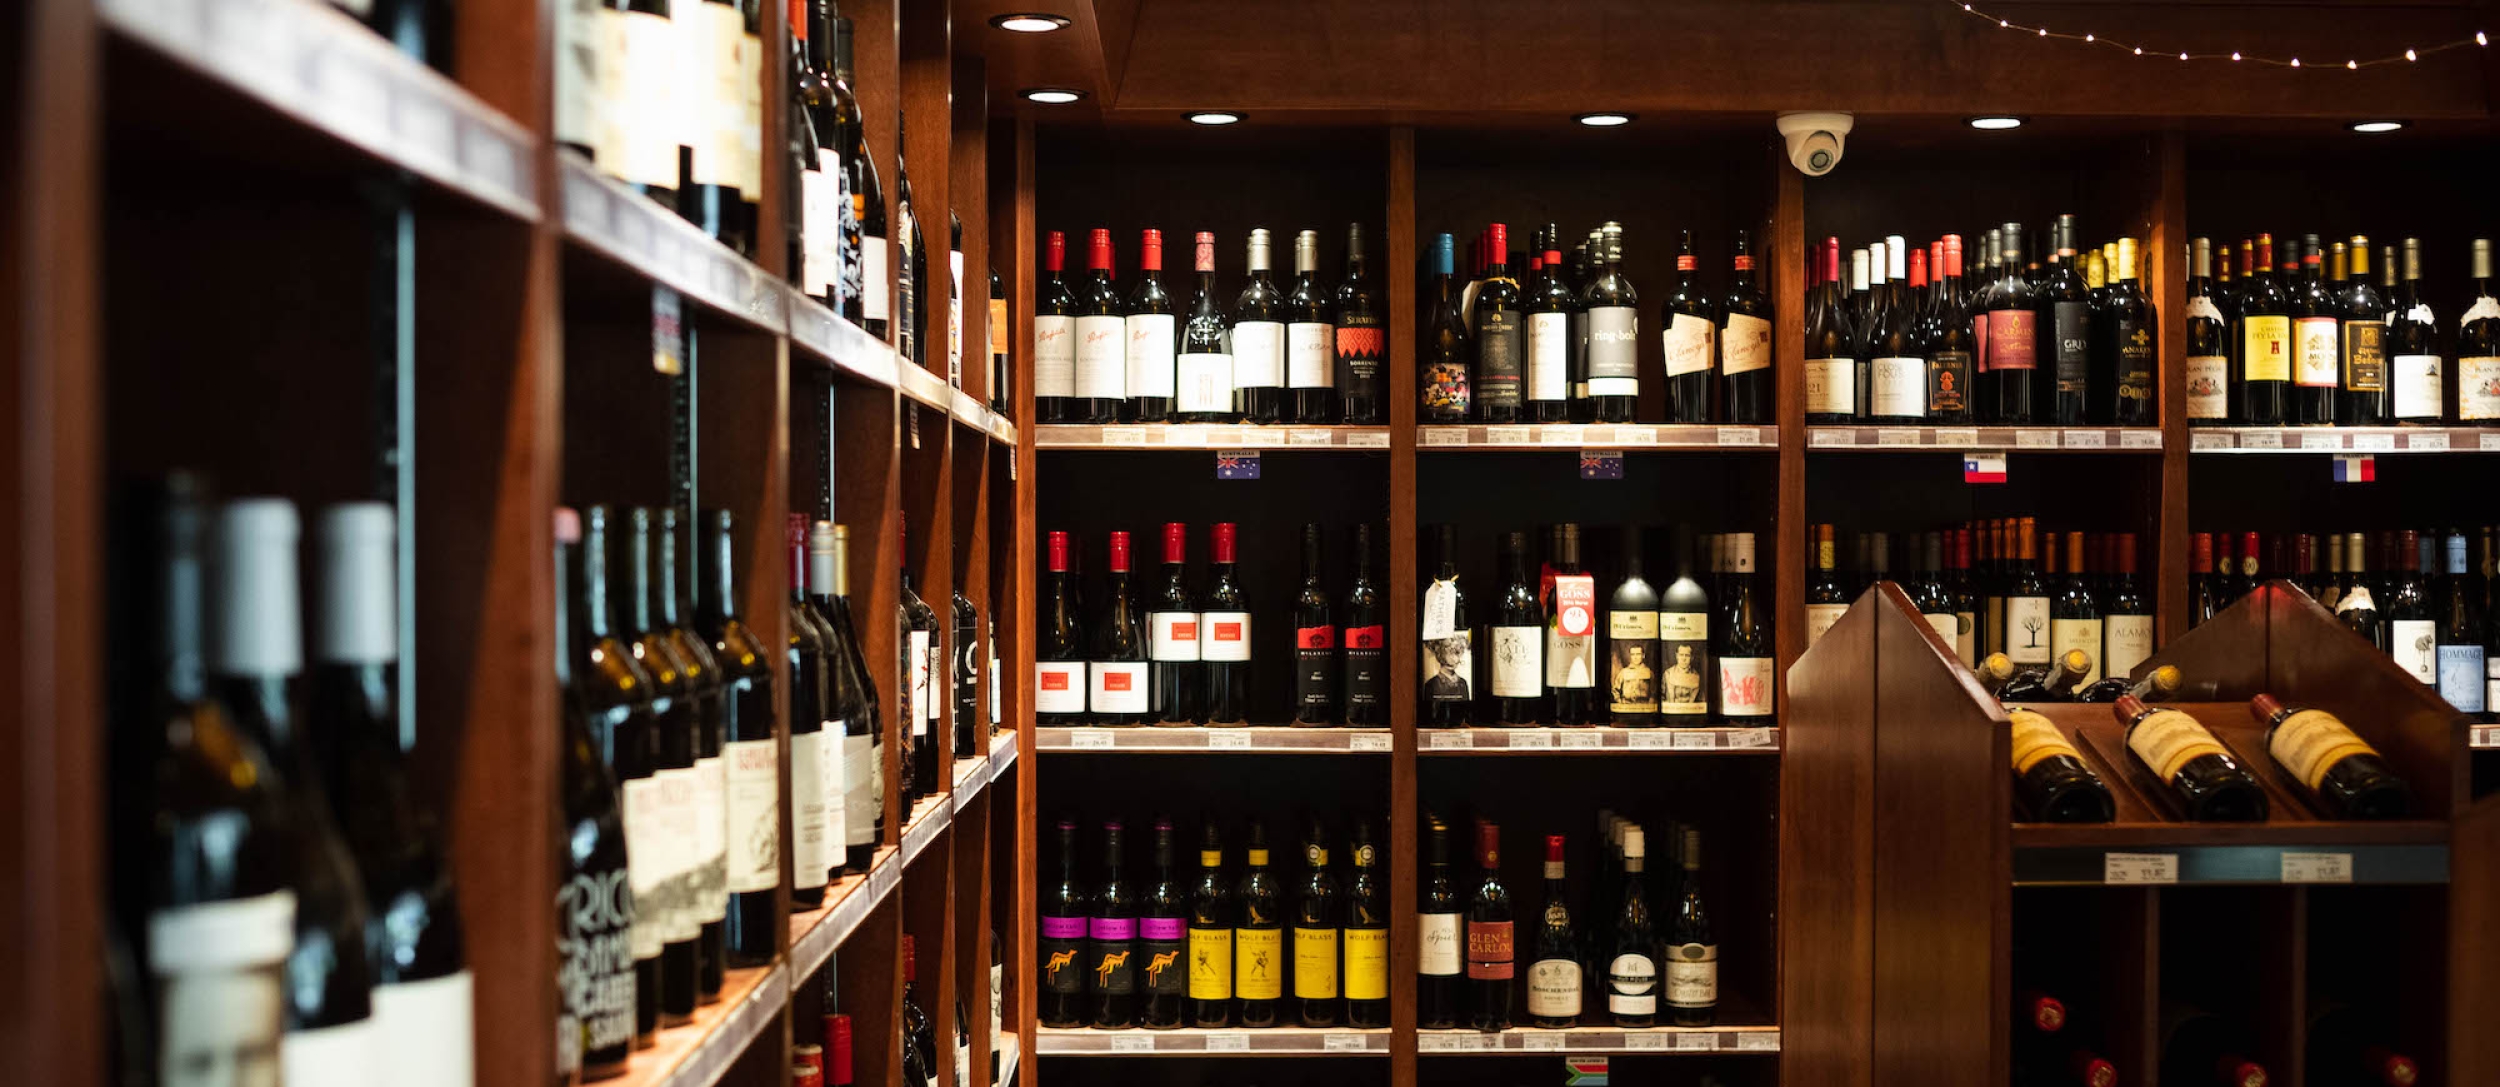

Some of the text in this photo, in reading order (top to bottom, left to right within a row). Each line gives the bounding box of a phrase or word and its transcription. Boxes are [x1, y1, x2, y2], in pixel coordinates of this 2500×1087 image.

[1594, 329, 1616, 344] ring
[1559, 589, 1591, 599] GOSS
[2440, 648, 2483, 660] HOMMAGE
[1469, 932, 1500, 943] GLEN
